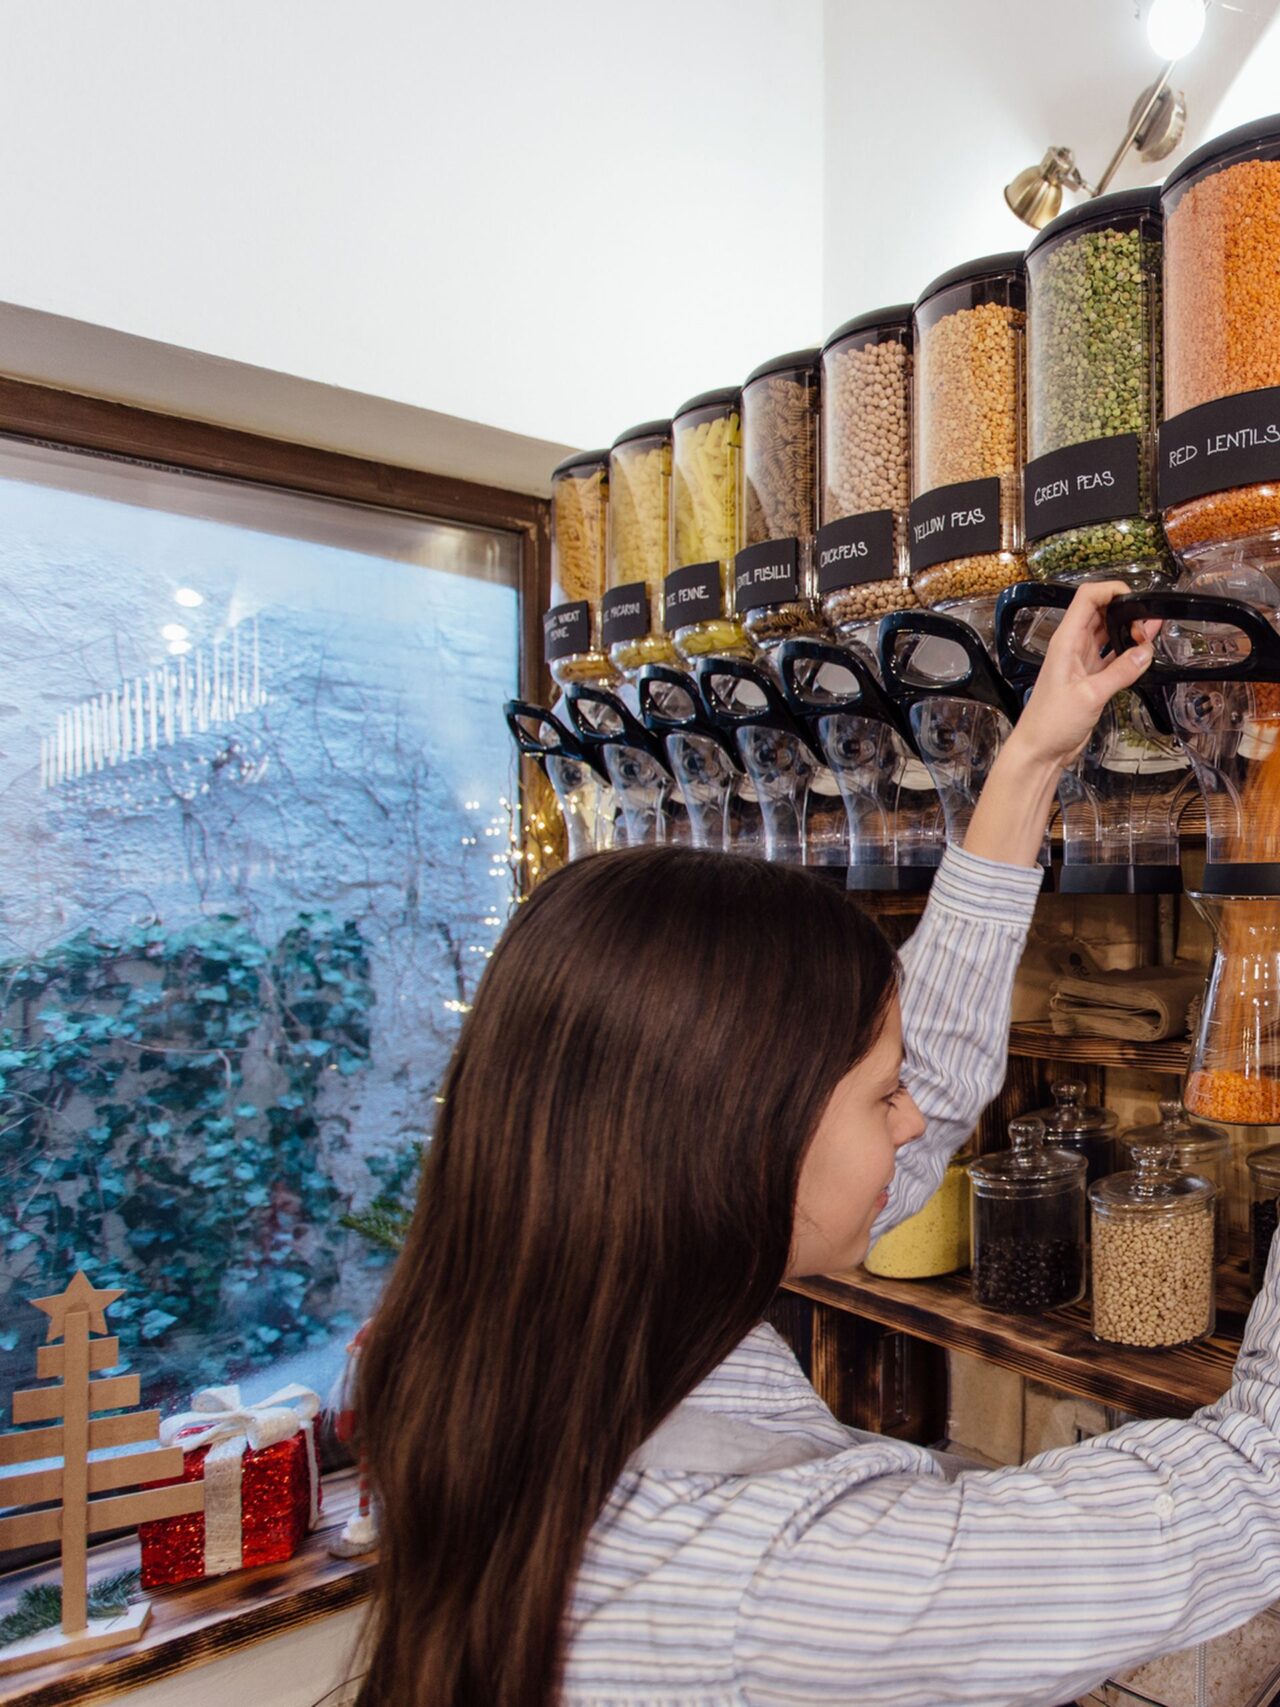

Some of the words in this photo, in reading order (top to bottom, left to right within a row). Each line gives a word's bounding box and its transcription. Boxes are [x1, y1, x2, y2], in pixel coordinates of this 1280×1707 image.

[1168, 445, 1198, 468] RED
[1034, 480, 1069, 506] GREEN
[1077, 470, 1115, 490] PEAS
[913, 515, 946, 544] YELLOW
[951, 508, 986, 528] PEAS
[755, 563, 791, 583] FUSILLI
[678, 585, 710, 604] PENNE
